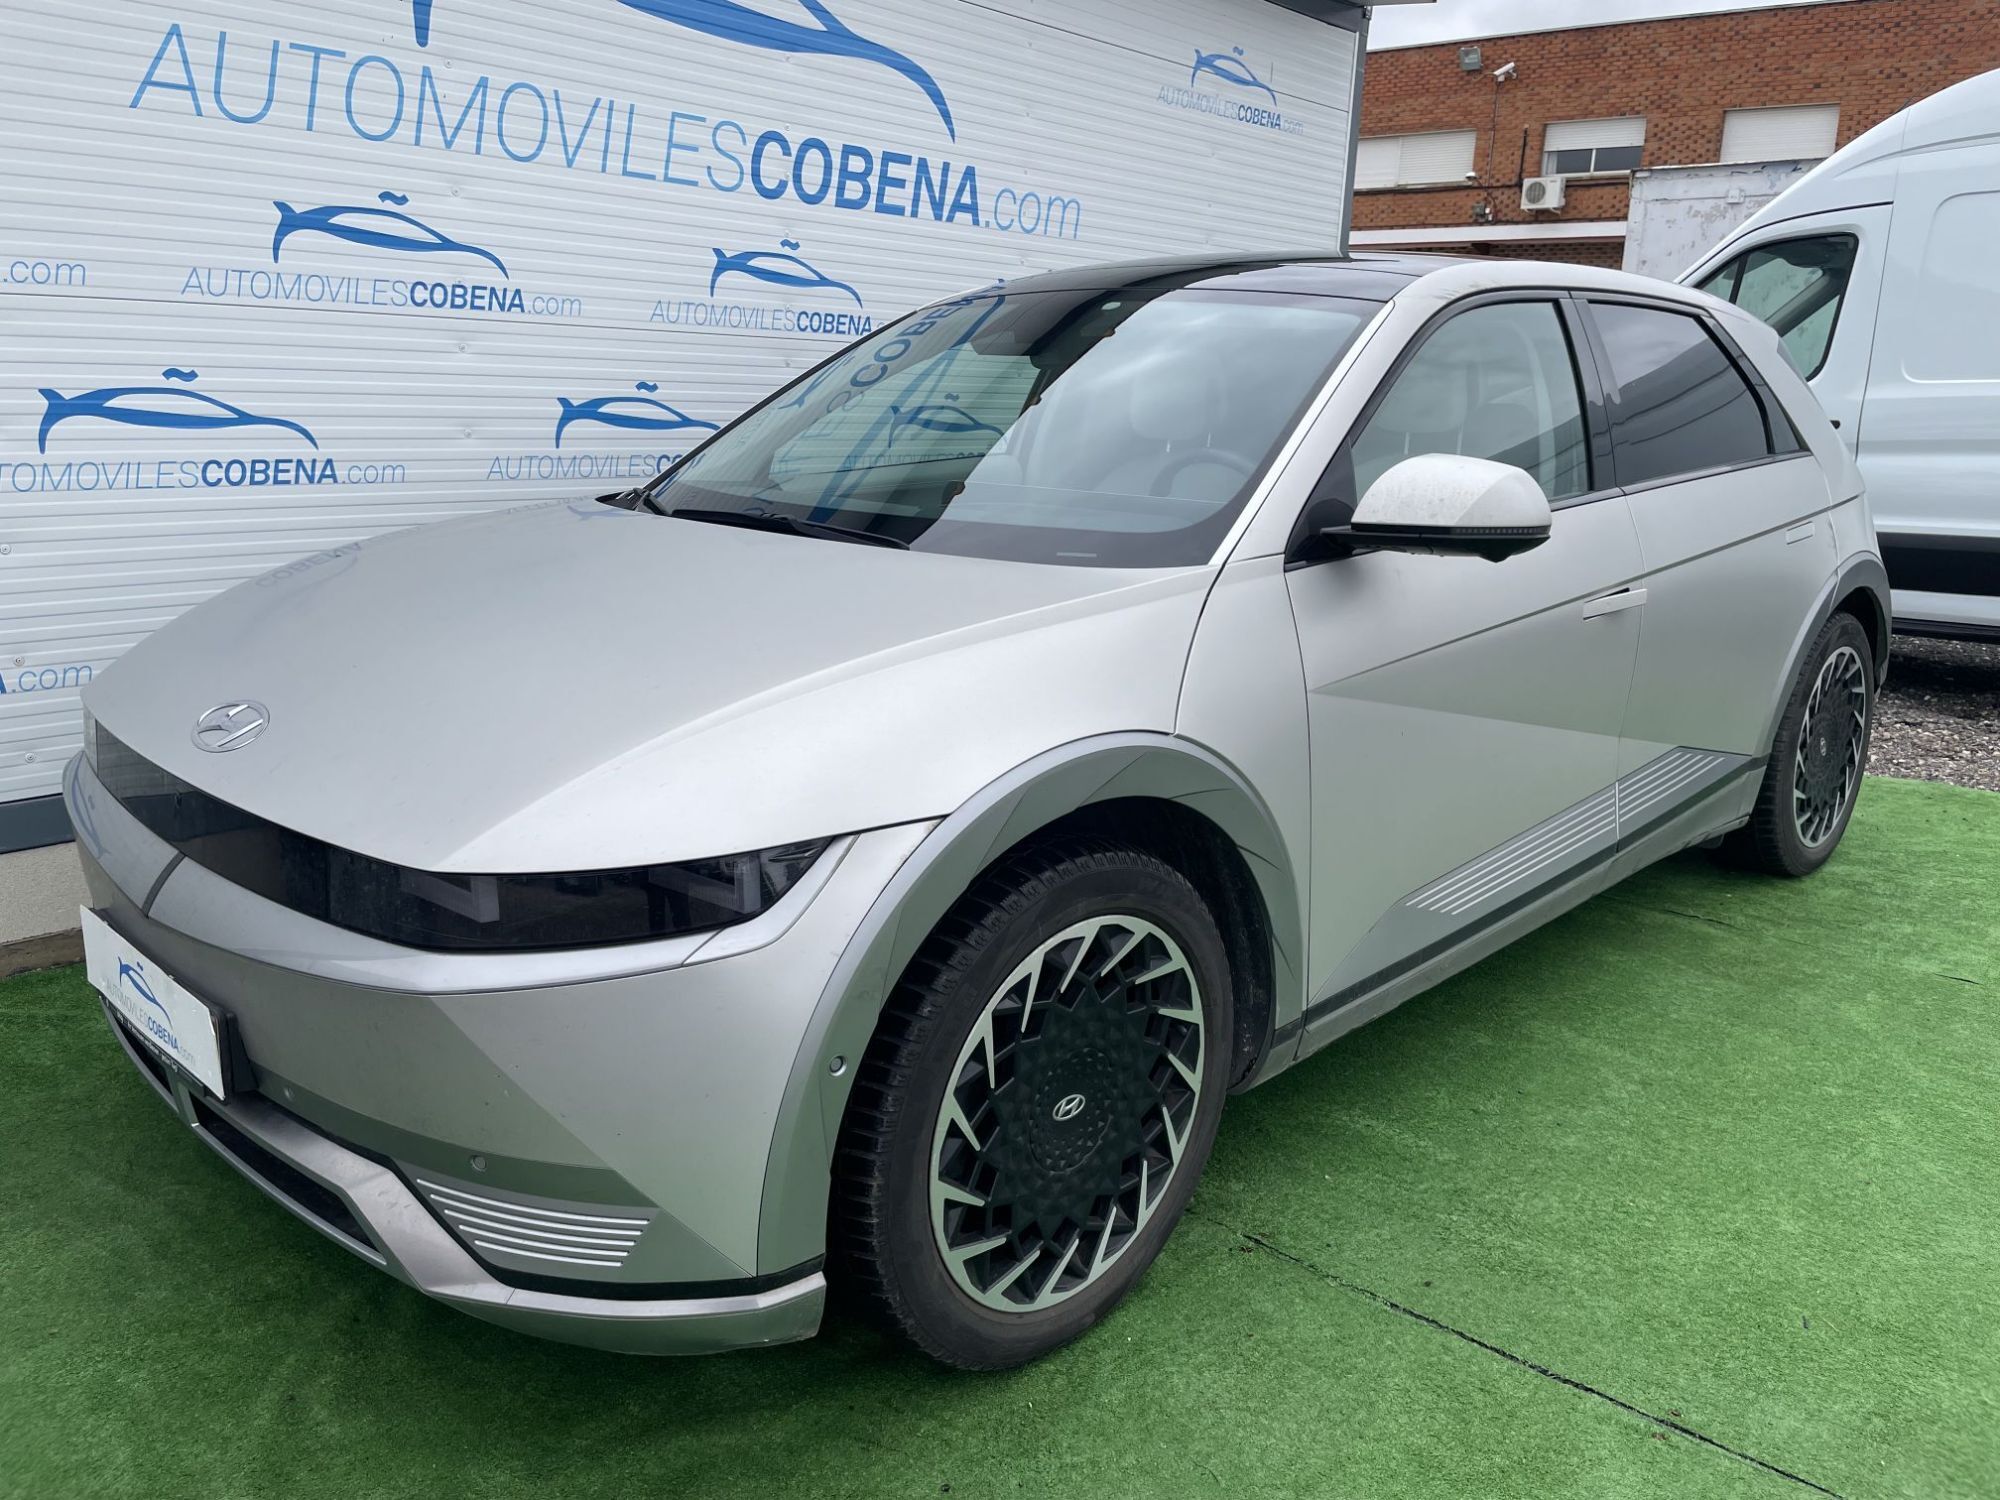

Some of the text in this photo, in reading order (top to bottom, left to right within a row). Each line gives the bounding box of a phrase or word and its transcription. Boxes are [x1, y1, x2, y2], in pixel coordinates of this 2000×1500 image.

[129, 23, 1081, 239] AUTOMOVILESCOBENA.com
[181, 266, 582, 317] AUTOMOVILESCOBENA.com
[650, 299, 885, 336] AUTOMOVILESCOBENA
